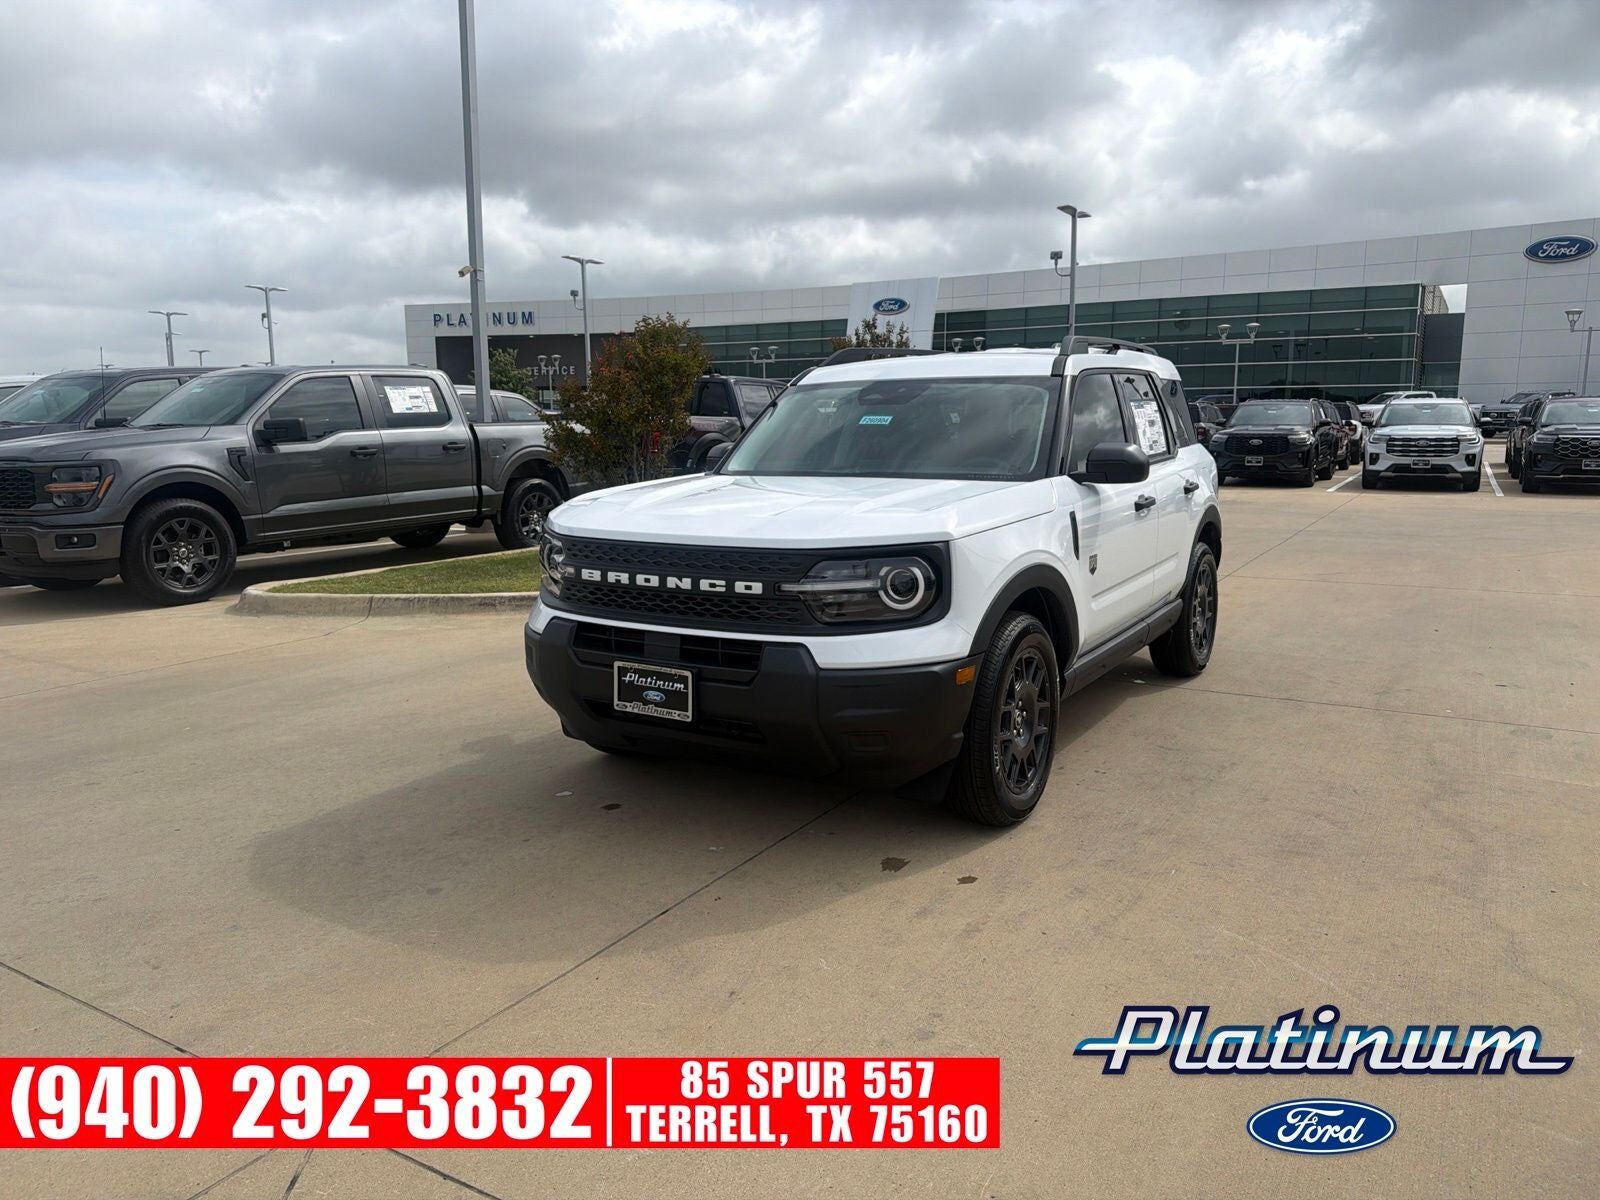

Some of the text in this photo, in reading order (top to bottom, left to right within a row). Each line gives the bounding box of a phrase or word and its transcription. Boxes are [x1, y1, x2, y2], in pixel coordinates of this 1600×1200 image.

[1538, 240, 1580, 257] Ford
[879, 300, 901, 311] Ford
[433, 311, 535, 326] PLANUM
[581, 568, 763, 595] BRONCO
[621, 672, 688, 692] Platinum
[631, 702, 677, 718] Platinum
